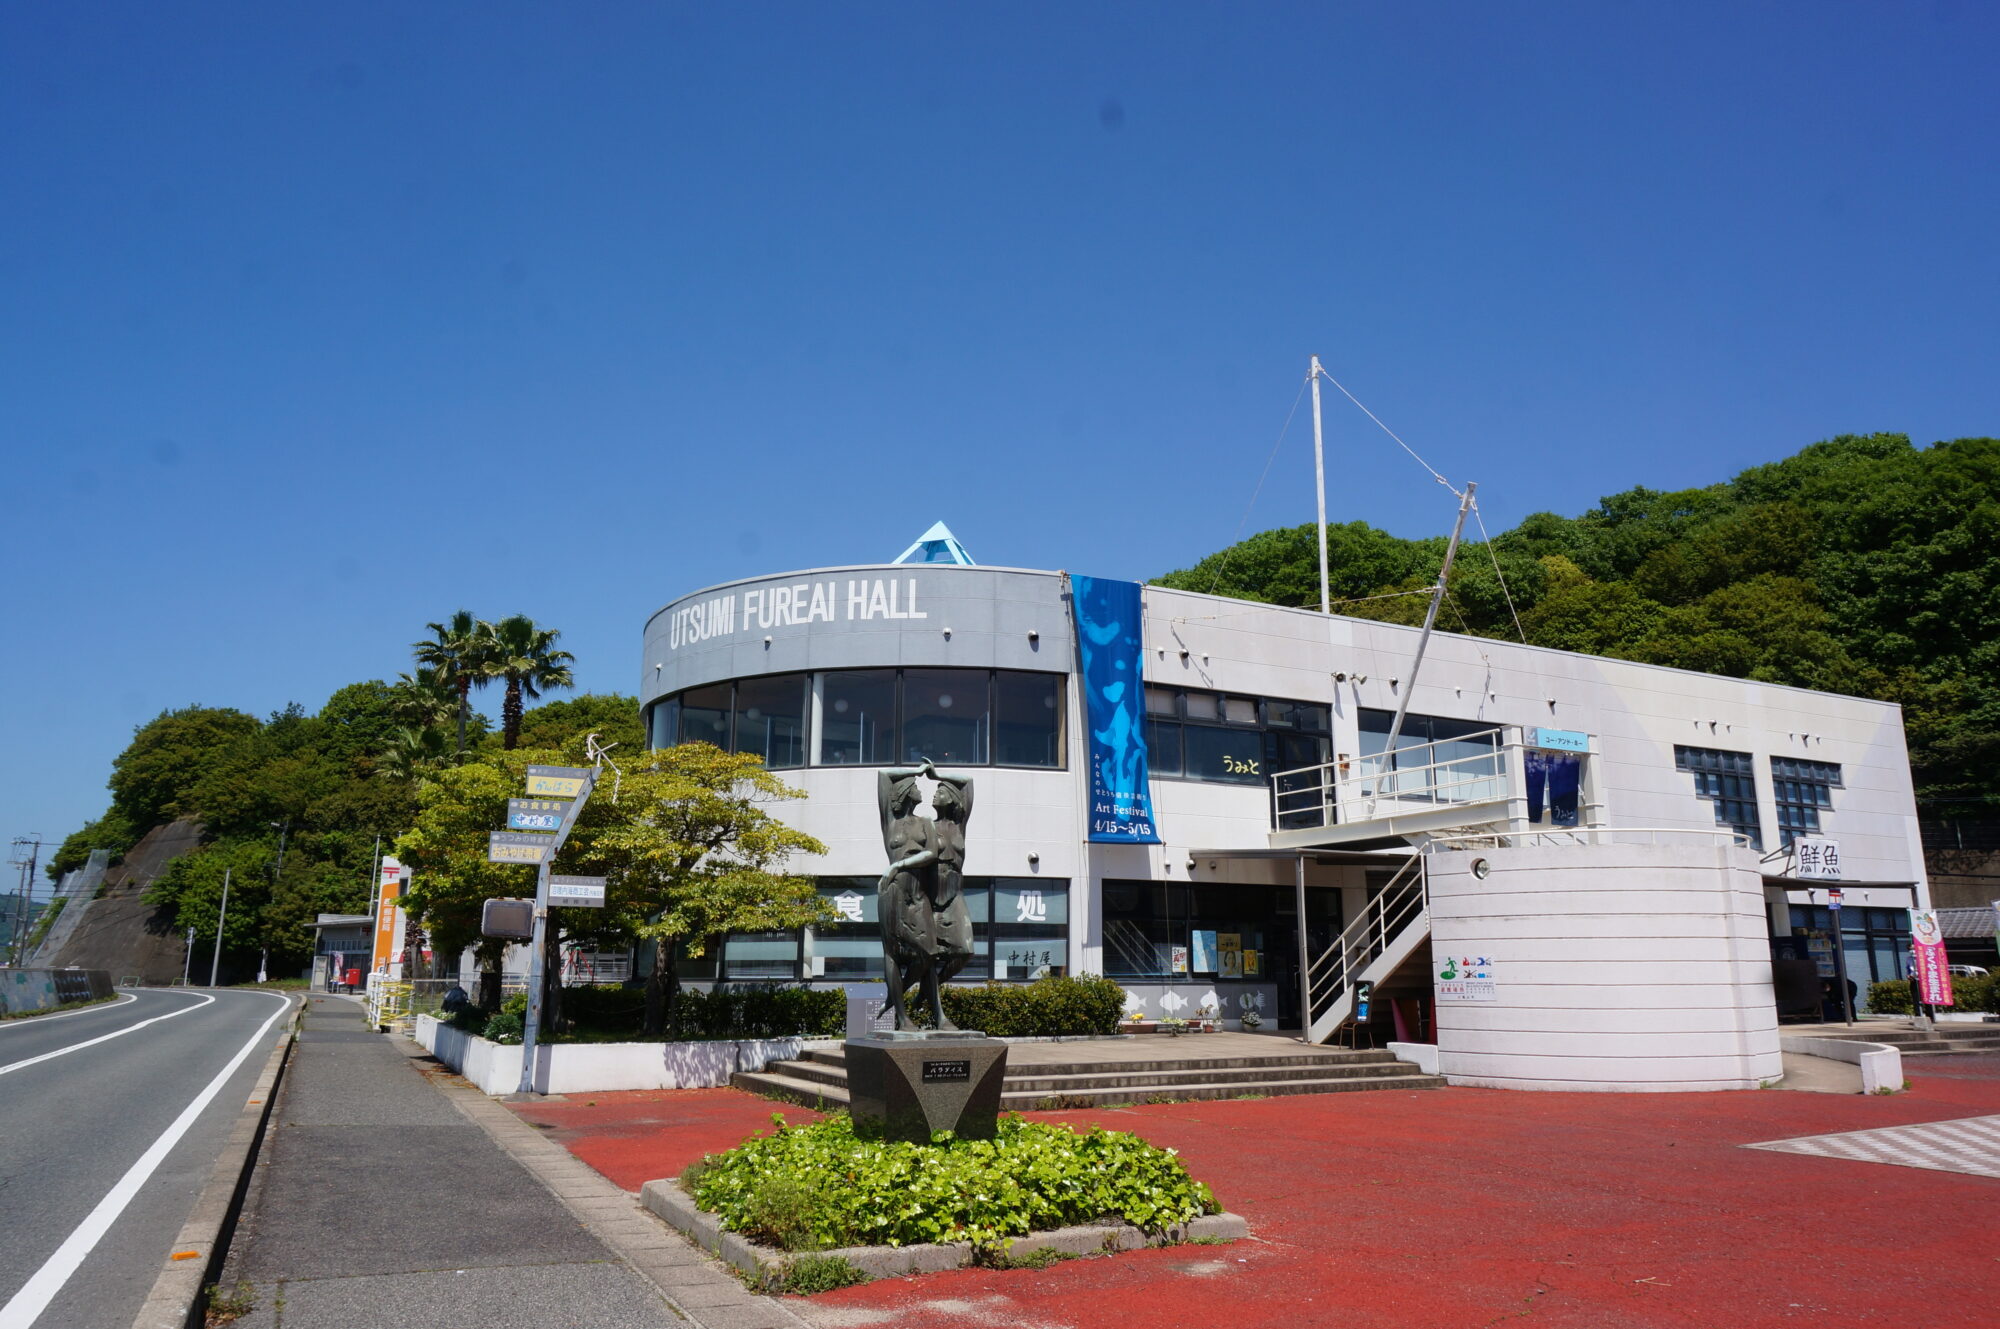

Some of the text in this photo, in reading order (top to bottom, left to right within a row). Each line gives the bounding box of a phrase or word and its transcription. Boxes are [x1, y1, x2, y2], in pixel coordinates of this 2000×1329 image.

[670, 579, 928, 650] UTSUMI FUREAI HALL
[1223, 755, 1260, 775] うみと
[516, 813, 553, 826] 中村屋
[1095, 801, 1148, 817] Art Festival
[1799, 844, 1841, 875] 鮮魚
[834, 890, 864, 922] 食
[1017, 890, 1046, 922] 処
[1008, 950, 1053, 967] 中村屋
